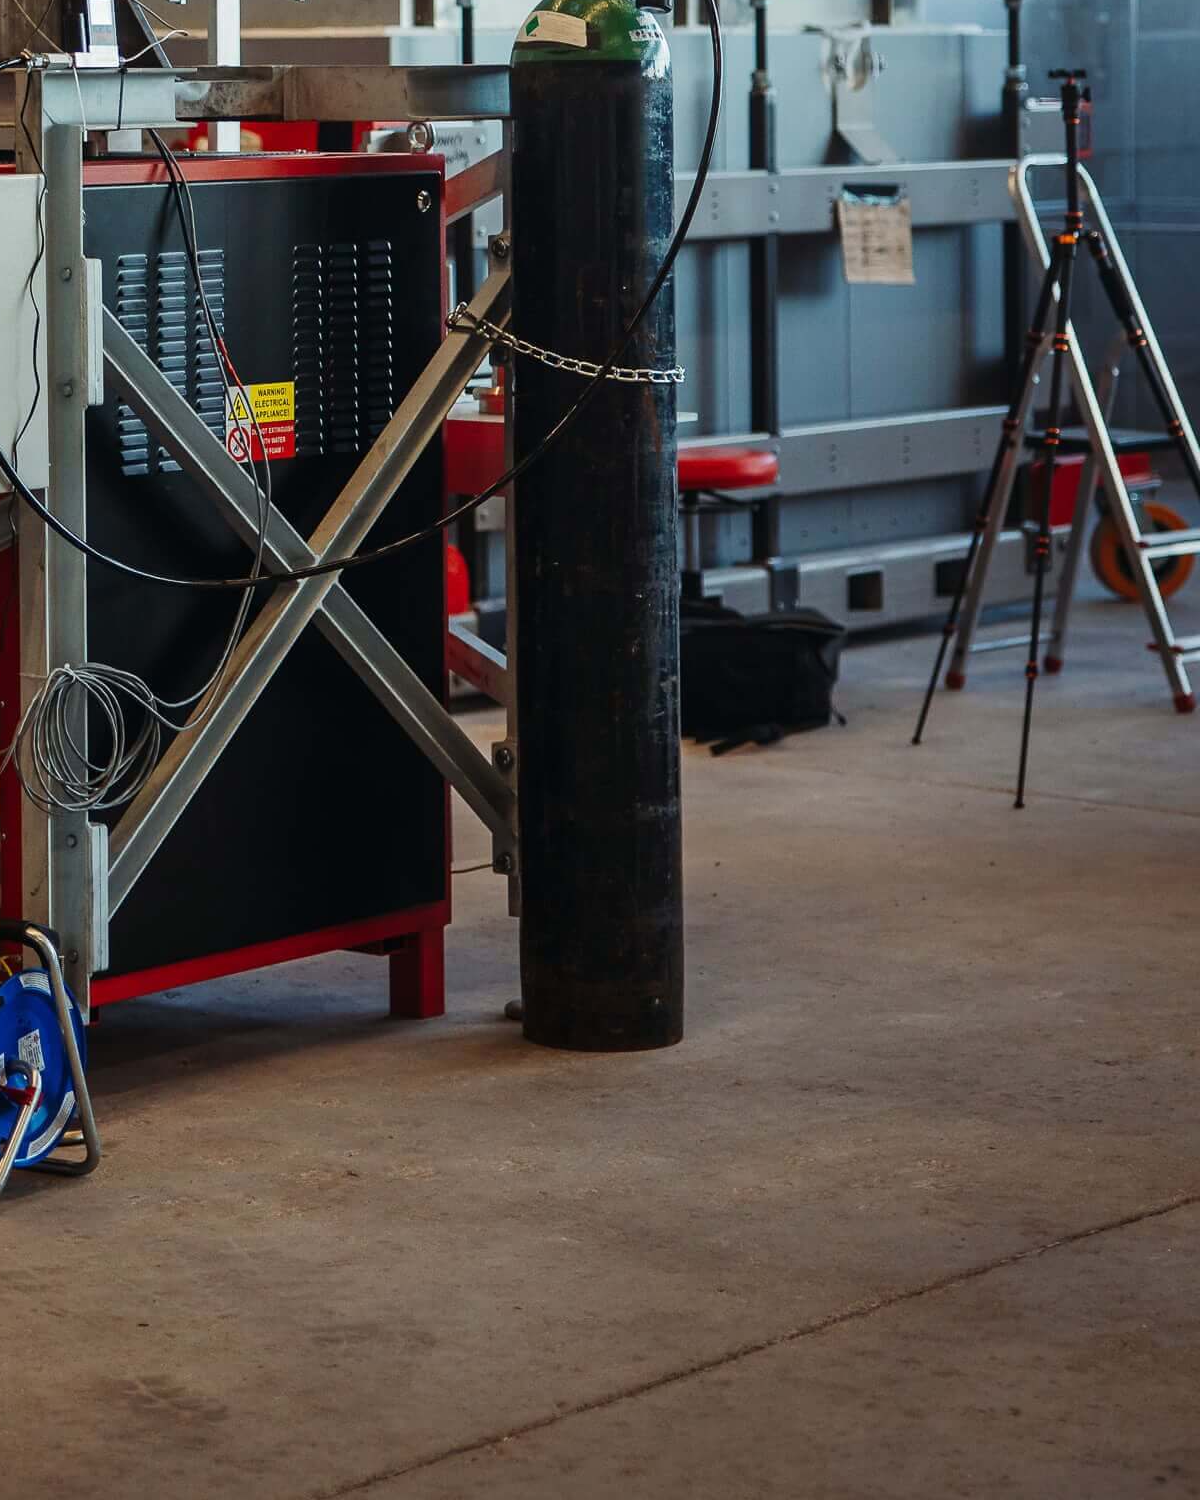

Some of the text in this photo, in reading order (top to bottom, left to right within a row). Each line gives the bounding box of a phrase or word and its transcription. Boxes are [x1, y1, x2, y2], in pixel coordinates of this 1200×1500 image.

[257, 388, 287, 396] WARNING!
[255, 398, 290, 408] ELECTRICAL
[255, 409, 290, 418] APPLIANCE!
